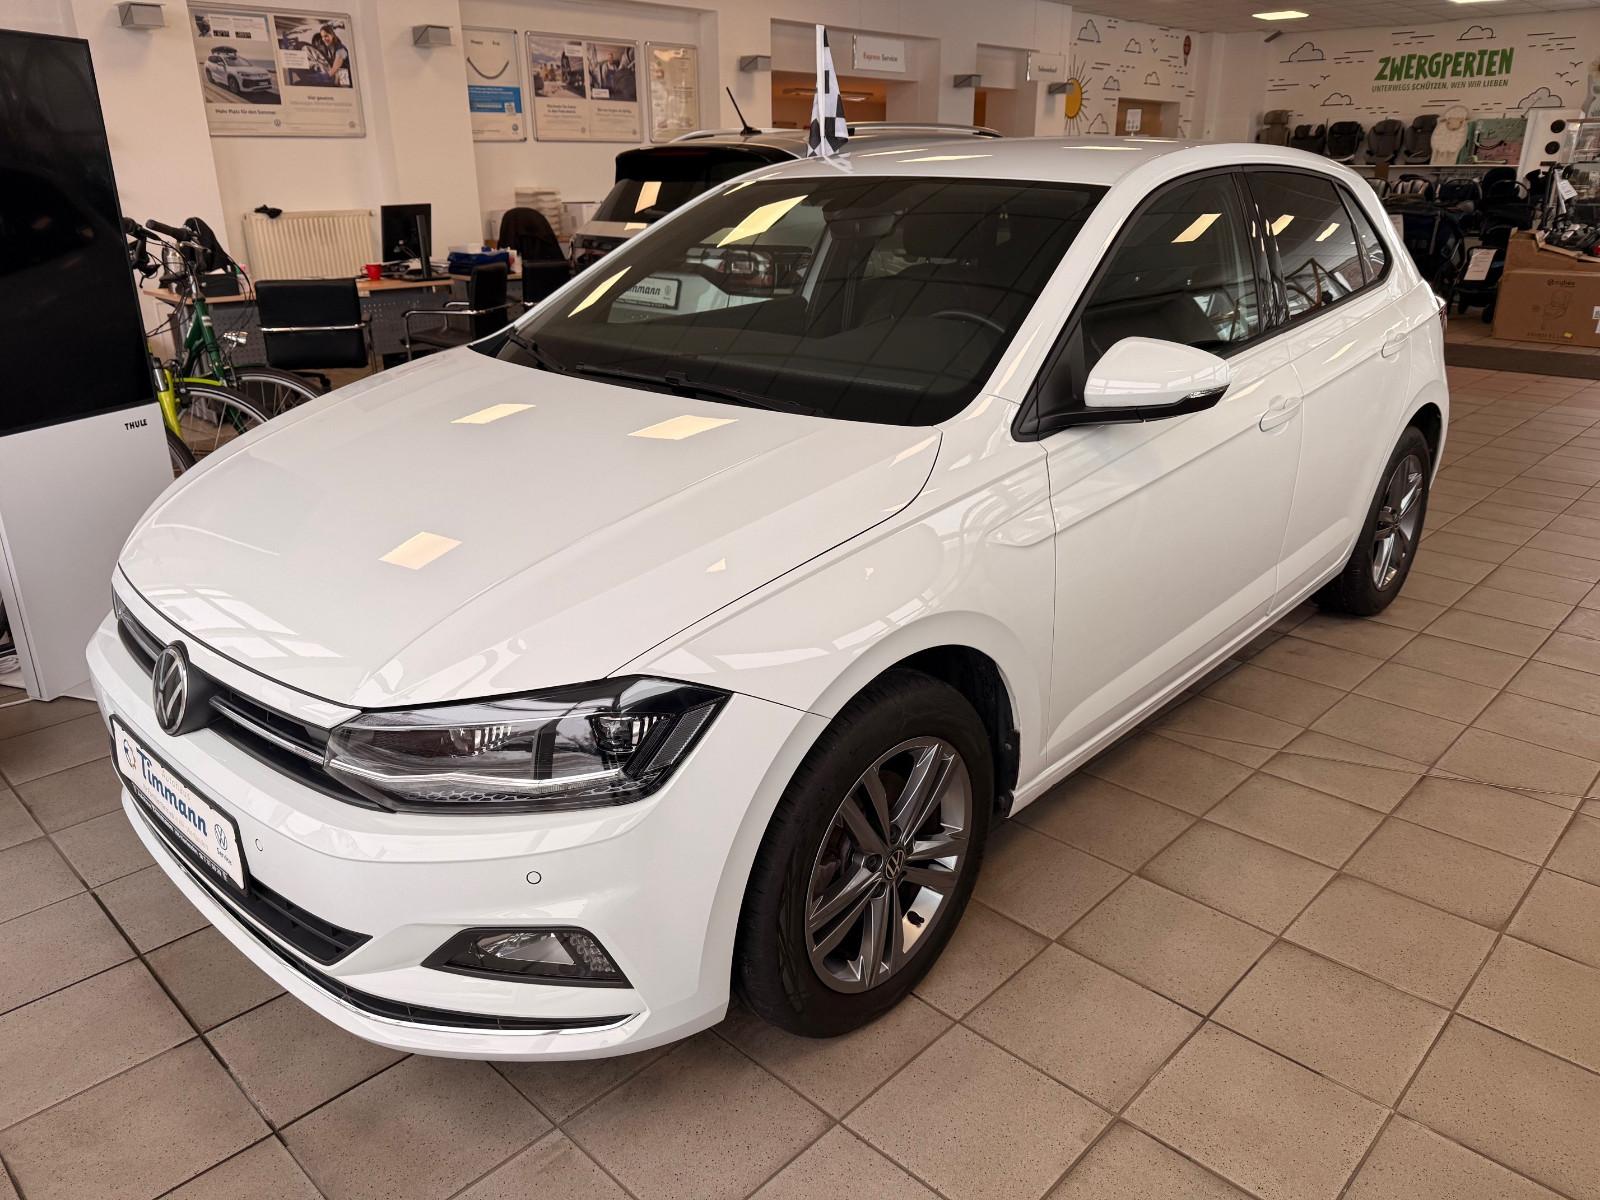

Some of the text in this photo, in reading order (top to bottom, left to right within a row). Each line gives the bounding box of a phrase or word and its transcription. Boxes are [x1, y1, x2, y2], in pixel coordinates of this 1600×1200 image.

[1374, 46, 1515, 82] ZWERGPERTEN
[1371, 83, 1411, 93] UNTERWEGS
[1450, 81, 1466, 89] WEN
[1468, 80, 1481, 88] WIR
[1482, 79, 1509, 88] LIEBEN
[124, 418, 148, 431] THULE
[135, 746, 208, 837] Timmann
